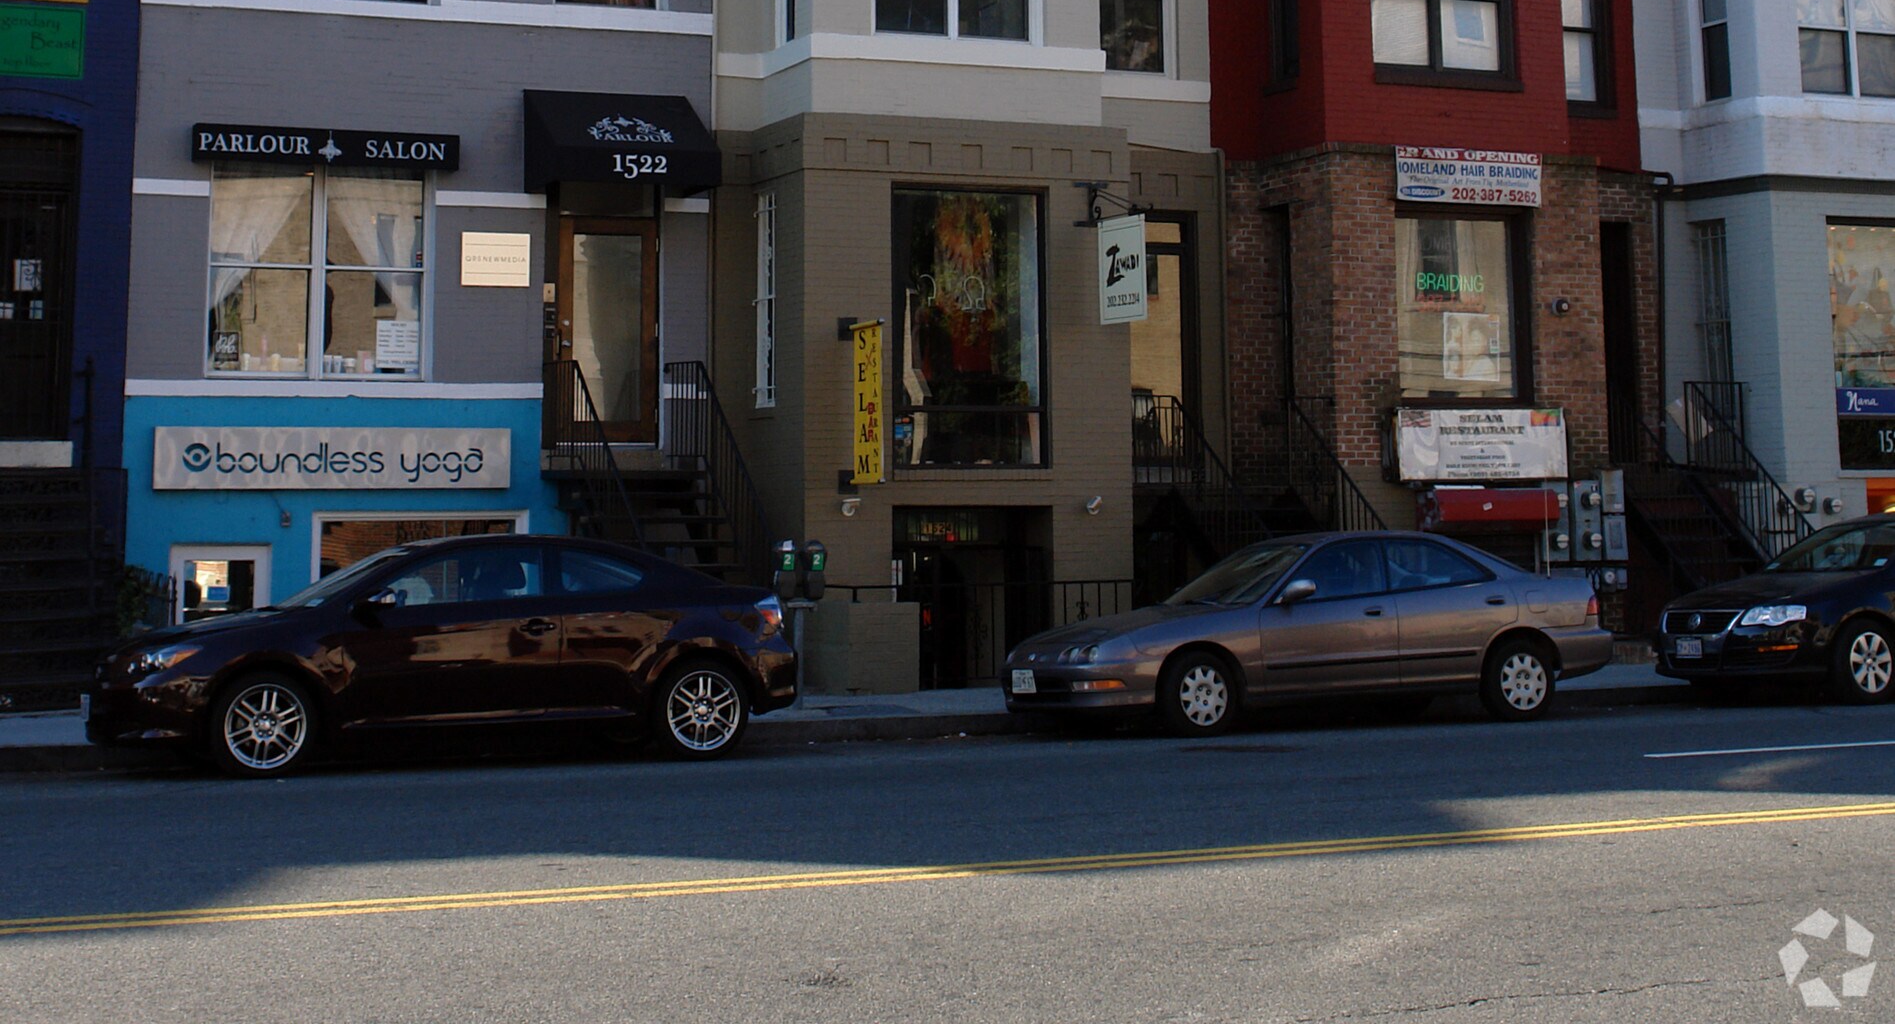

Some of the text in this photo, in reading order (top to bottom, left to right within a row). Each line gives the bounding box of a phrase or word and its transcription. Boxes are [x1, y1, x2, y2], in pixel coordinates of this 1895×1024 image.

[31, 32, 77, 50] Beast
[198, 132, 446, 161] PARLOUR SALON
[593, 132, 675, 144] PARLOUR
[1397, 146, 1538, 164] GRAND OPENING
[612, 154, 668, 179] 1522
[1460, 164, 1485, 177] HAIR
[1489, 165, 1538, 180] BRAIDING
[1416, 272, 1484, 292] BRAIDING
[857, 330, 870, 475] SELAM
[1846, 390, 1879, 412] Nana
[867, 402, 876, 442] BAR
[1459, 414, 1504, 423] SELAM
[1439, 426, 1525, 435] RESTAURANT
[1878, 429, 1895, 453] 15
[216, 442, 484, 483] boundless yoga
[783, 554, 791, 565] 2
[813, 554, 820, 565] 2
